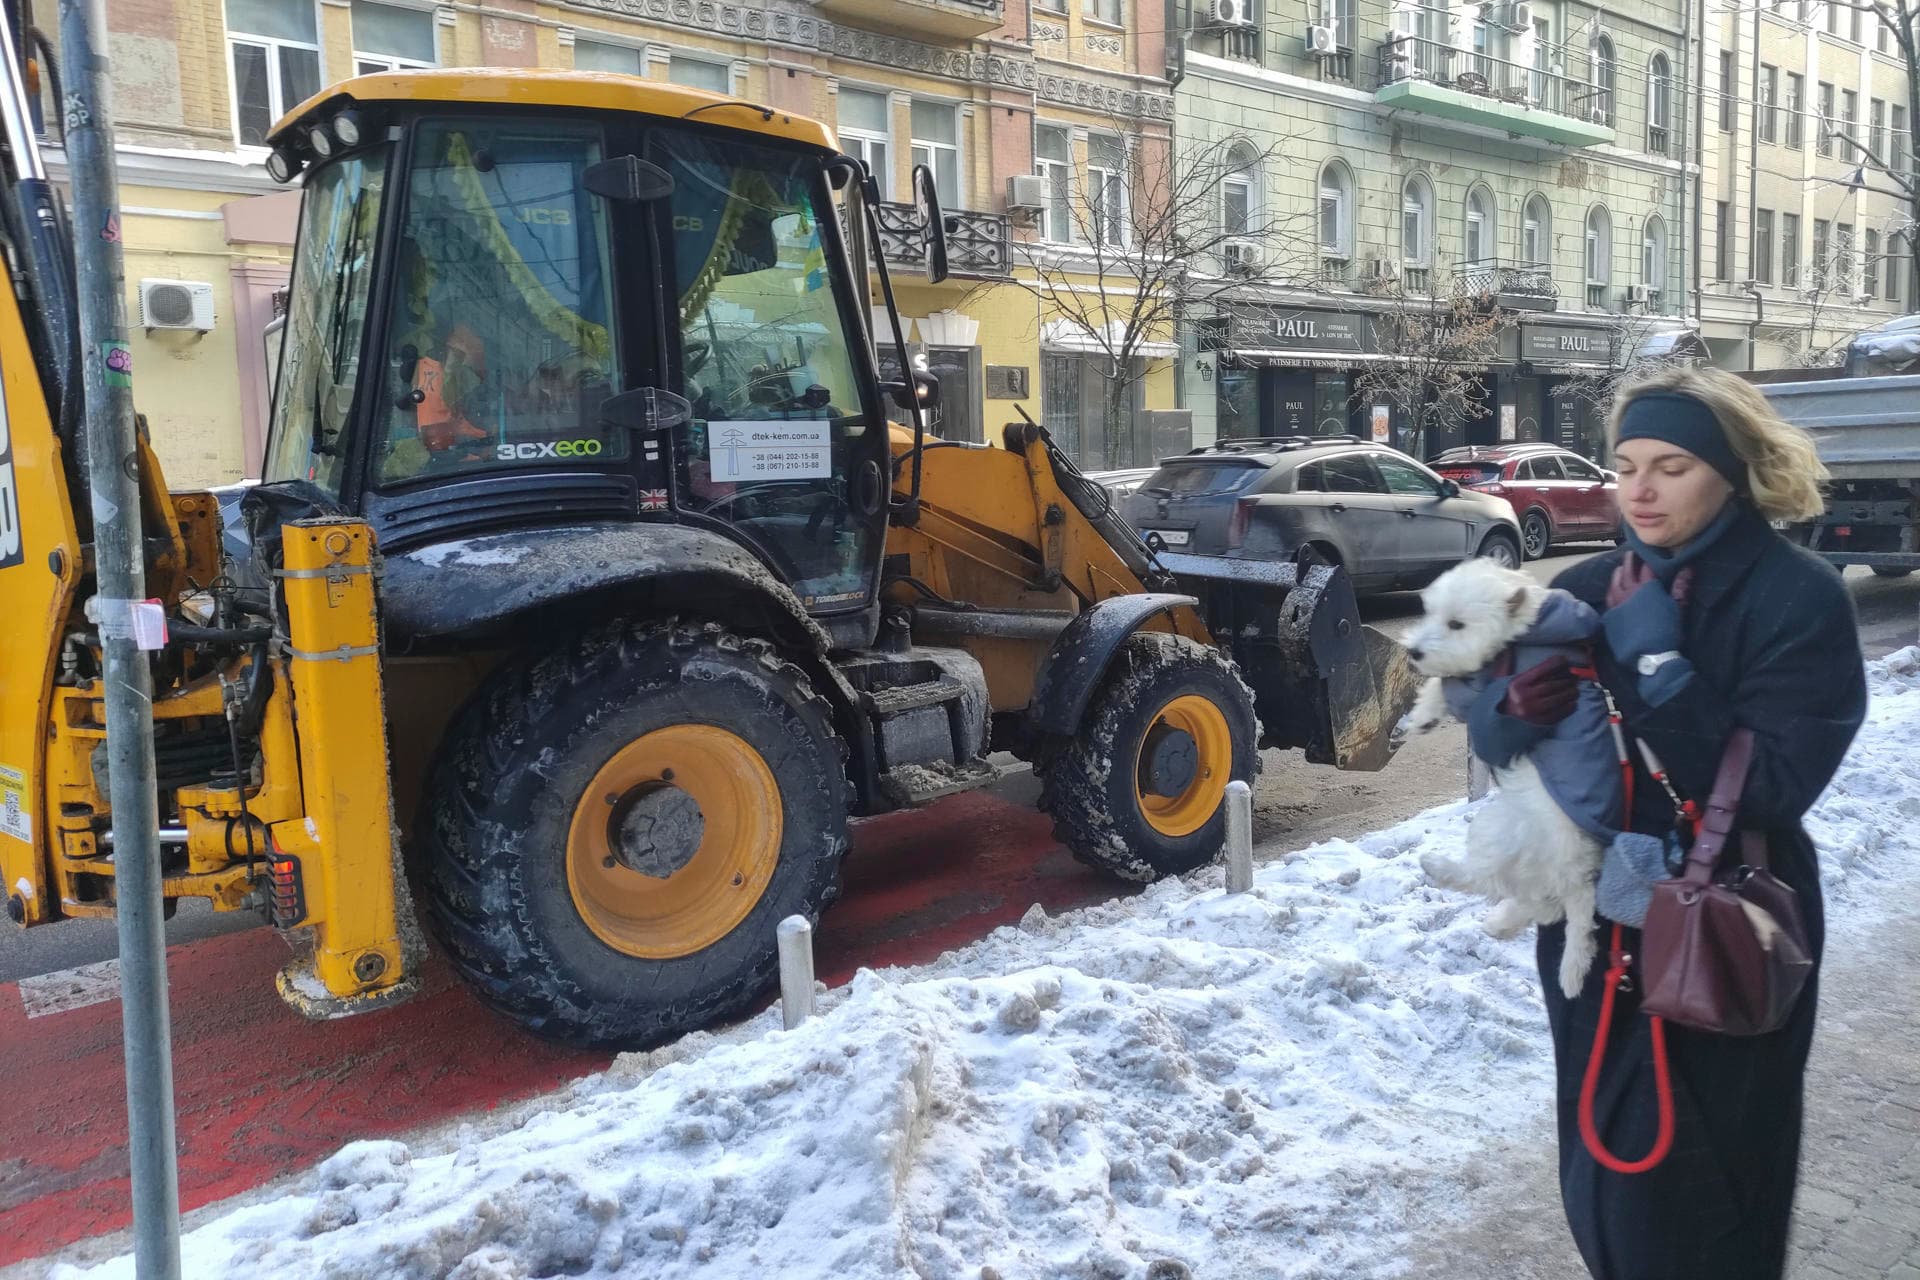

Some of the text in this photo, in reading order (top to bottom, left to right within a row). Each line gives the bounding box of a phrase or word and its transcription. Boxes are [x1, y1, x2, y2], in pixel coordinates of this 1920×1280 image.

[515, 207, 571, 225] JCB
[672, 215, 704, 231] CB
[1276, 319, 1318, 338] PAUL
[1560, 335, 1589, 351] PAUL
[1286, 402, 1303, 410] PAUL
[752, 432, 820, 441] dtek-kem.com.ua
